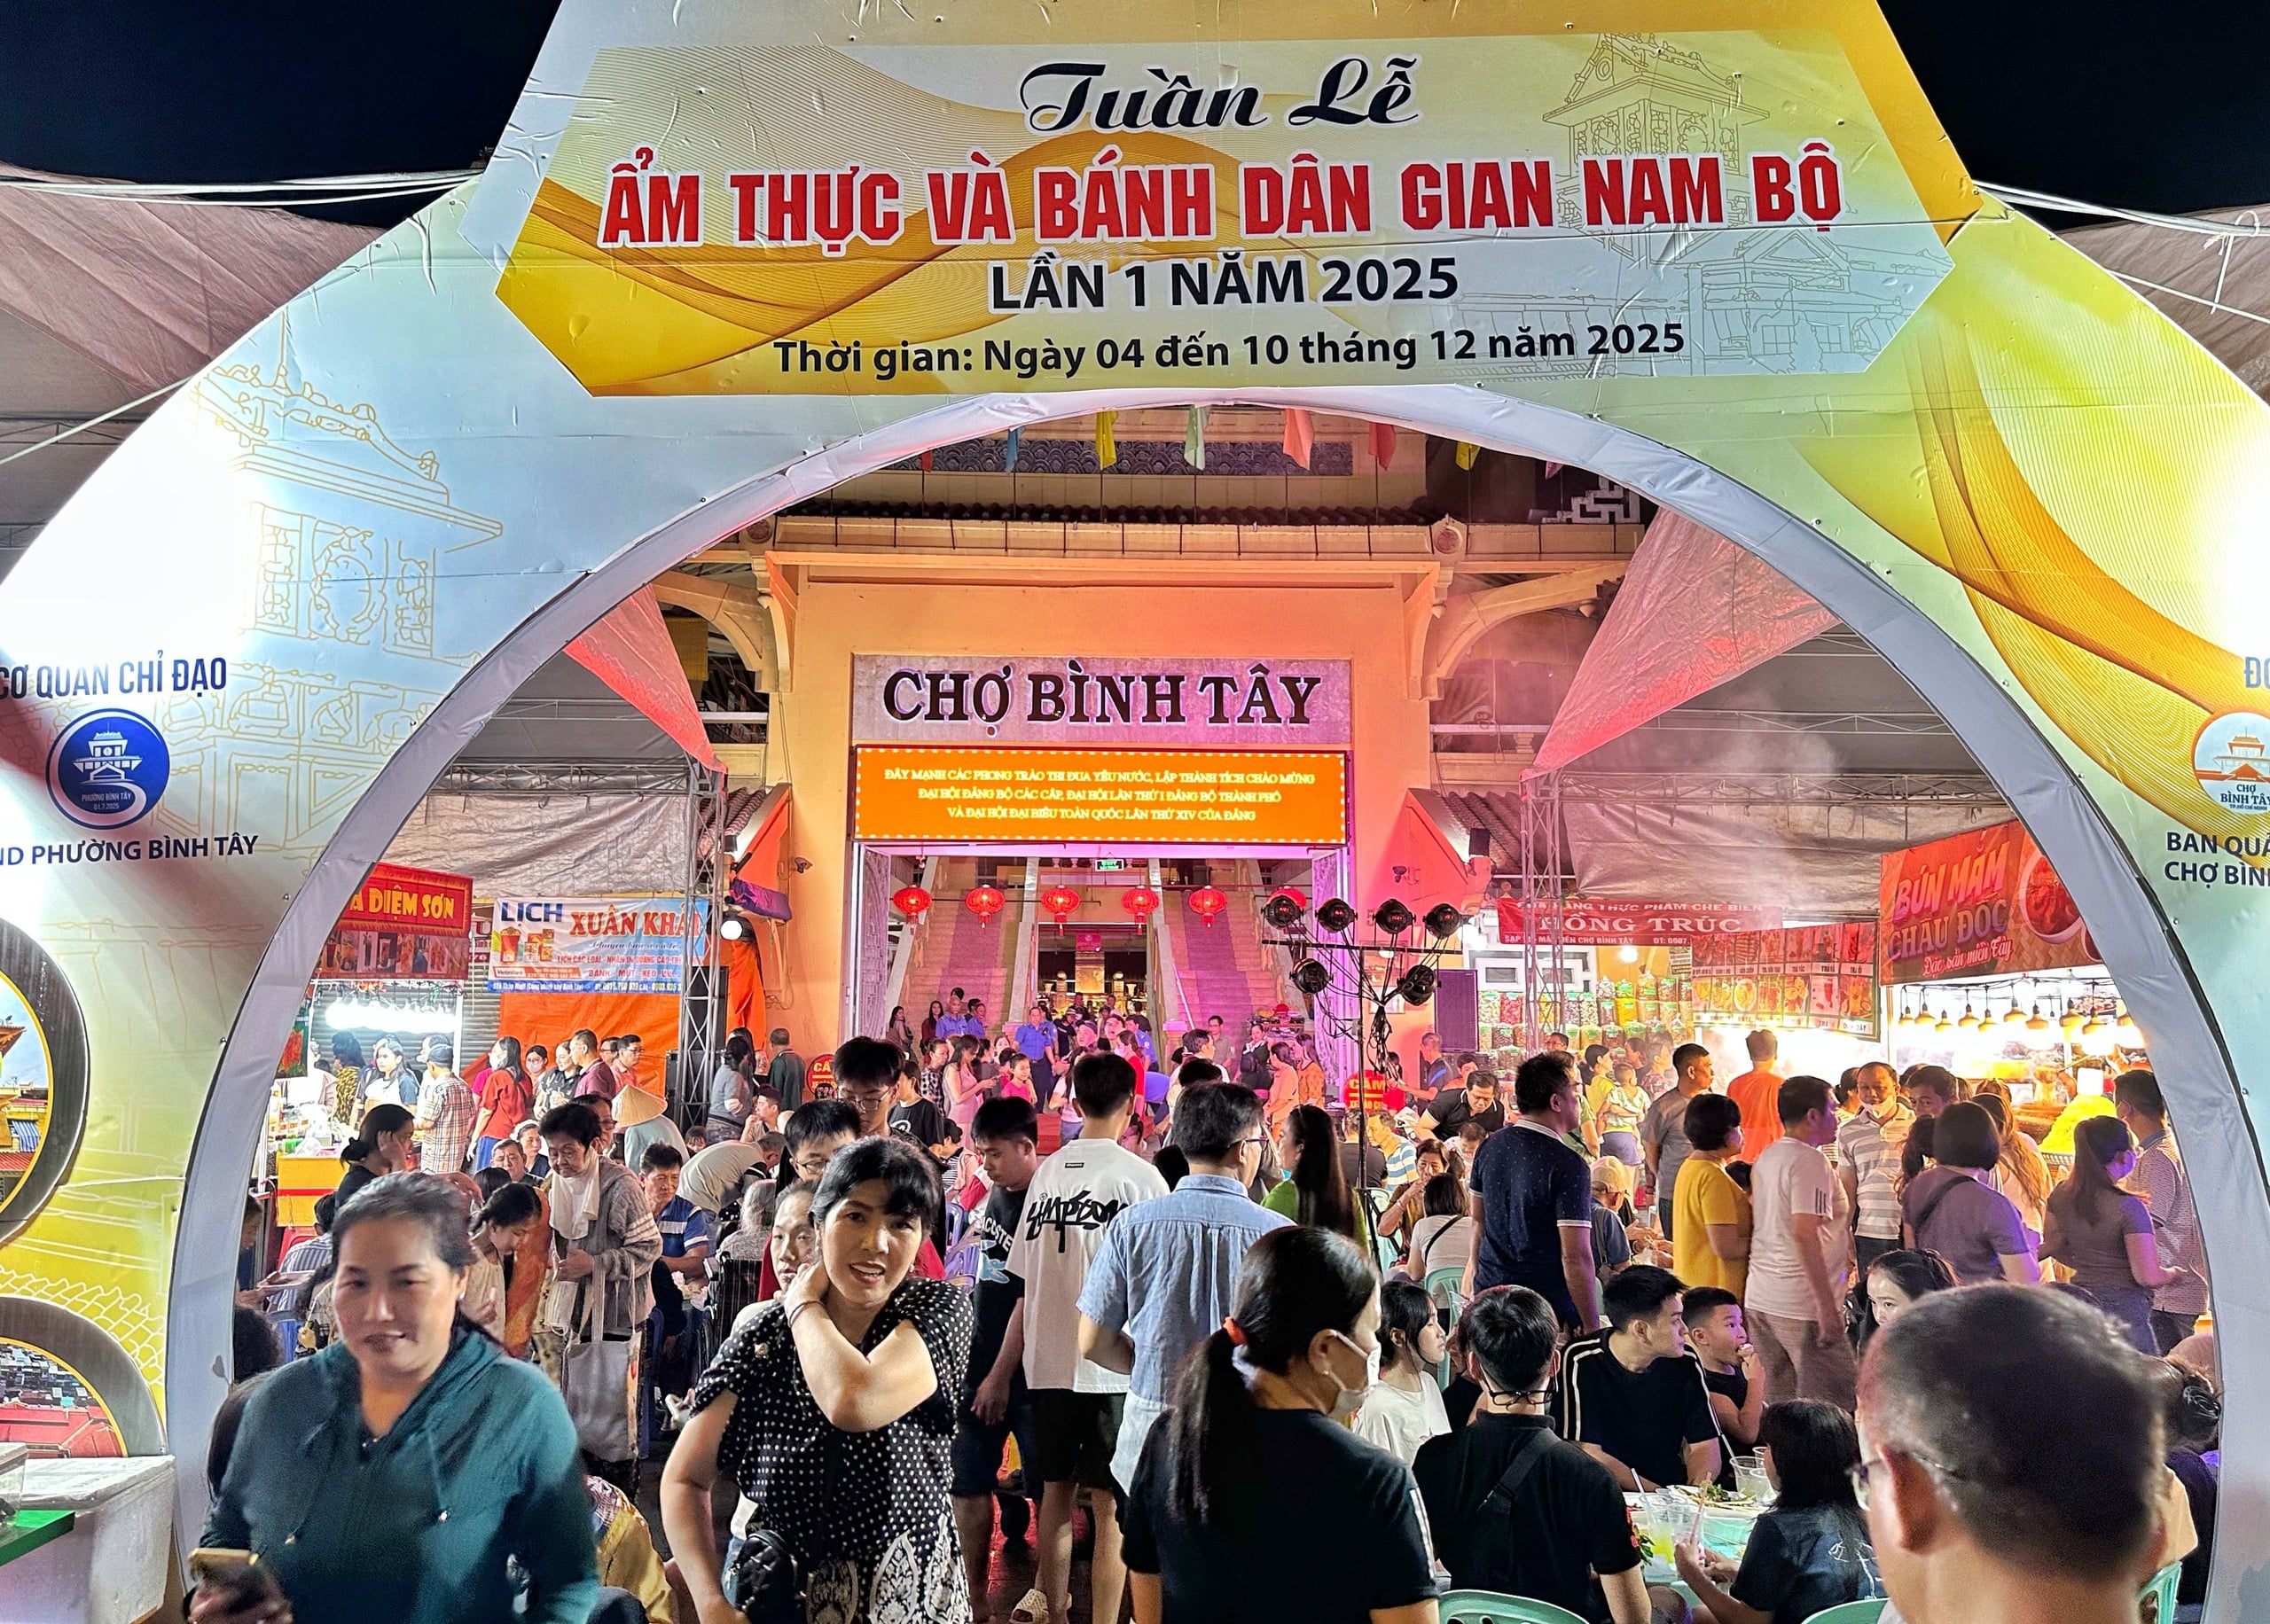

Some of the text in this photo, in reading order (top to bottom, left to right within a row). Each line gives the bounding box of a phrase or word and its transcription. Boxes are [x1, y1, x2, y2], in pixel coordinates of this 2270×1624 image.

[1021, 57, 1419, 132] Tuần Lễ
[602, 142, 1841, 253] ẨM THỰC VÀ BÁNH DÂN GIAN NAM BỘ
[992, 247, 1458, 309] LẦN 1 NĂM 2025
[773, 323, 1685, 381] Thời gian: Ngày 04 đến 10 tháng 12 năm 2025
[35, 664, 109, 699] QUAN
[119, 650, 163, 694] CHỈ
[172, 657, 227, 698] ĐẠO
[883, 660, 1321, 737] CHỢ BÌNH TÂY
[973, 769, 1013, 781] PHONG
[1046, 769, 1065, 782] THI
[1067, 769, 1092, 782] ĐUA
[2236, 784, 2257, 795] CHỢ
[2220, 790, 2250, 804] BÌNH
[31, 839, 142, 865] PHƯỜNG
[148, 833, 209, 860] BÌNH
[214, 831, 260, 855] TÂY
[2166, 832, 2218, 854] BAN
[1893, 830, 2010, 924] BÚN MẮM
[2164, 860, 2270, 889] CHỢ BÌN
[368, 883, 418, 921] DIỆM
[422, 892, 455, 920] SƠN
[501, 902, 563, 926] LỊCH
[569, 903, 638, 937] XUÂN
[1647, 915, 1742, 933] TRÚC
